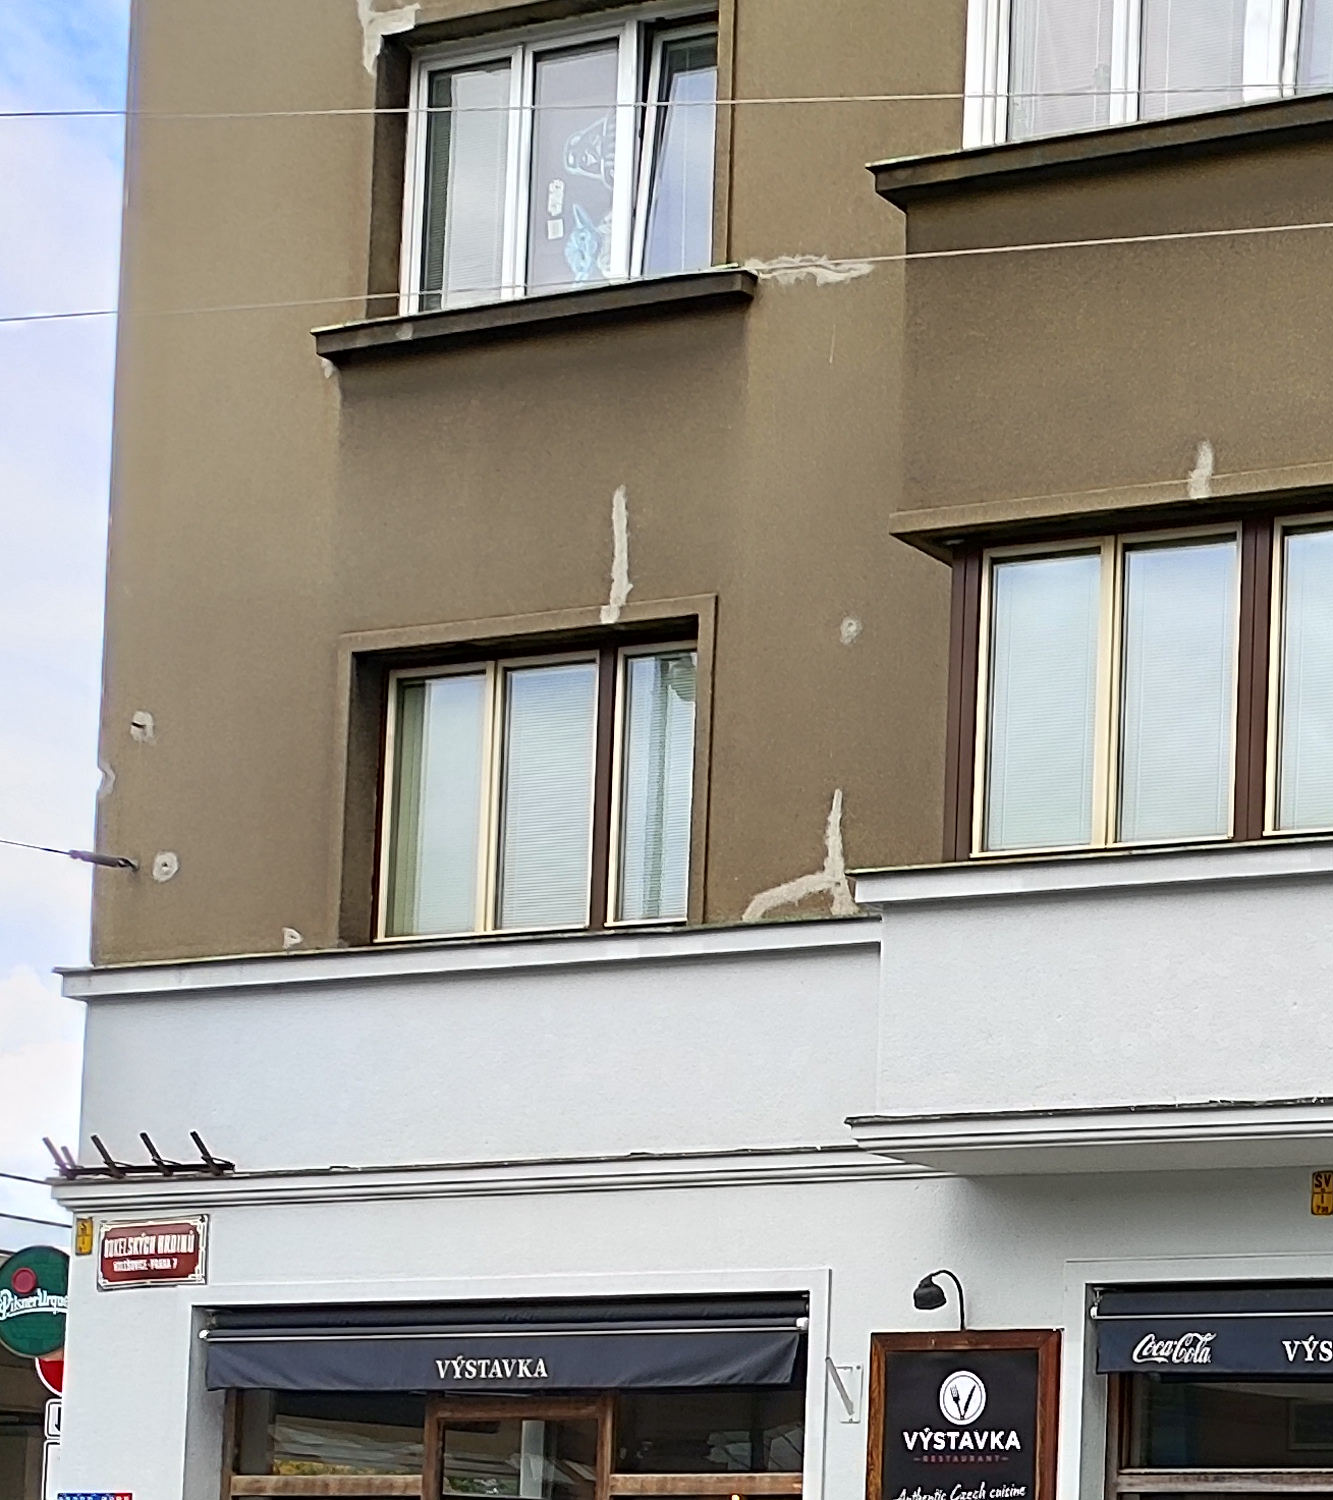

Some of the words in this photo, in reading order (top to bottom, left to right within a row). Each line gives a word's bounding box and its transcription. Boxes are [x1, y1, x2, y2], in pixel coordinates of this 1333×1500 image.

[37, 1287, 69, 1315] Urque
[1132, 1332, 1217, 1364] Coca-Cola
[435, 1354, 549, 1380] VÝSTAVKA
[903, 1427, 1021, 1451] VÝSTAVKA
[989, 1484, 1027, 1499] cuisine
